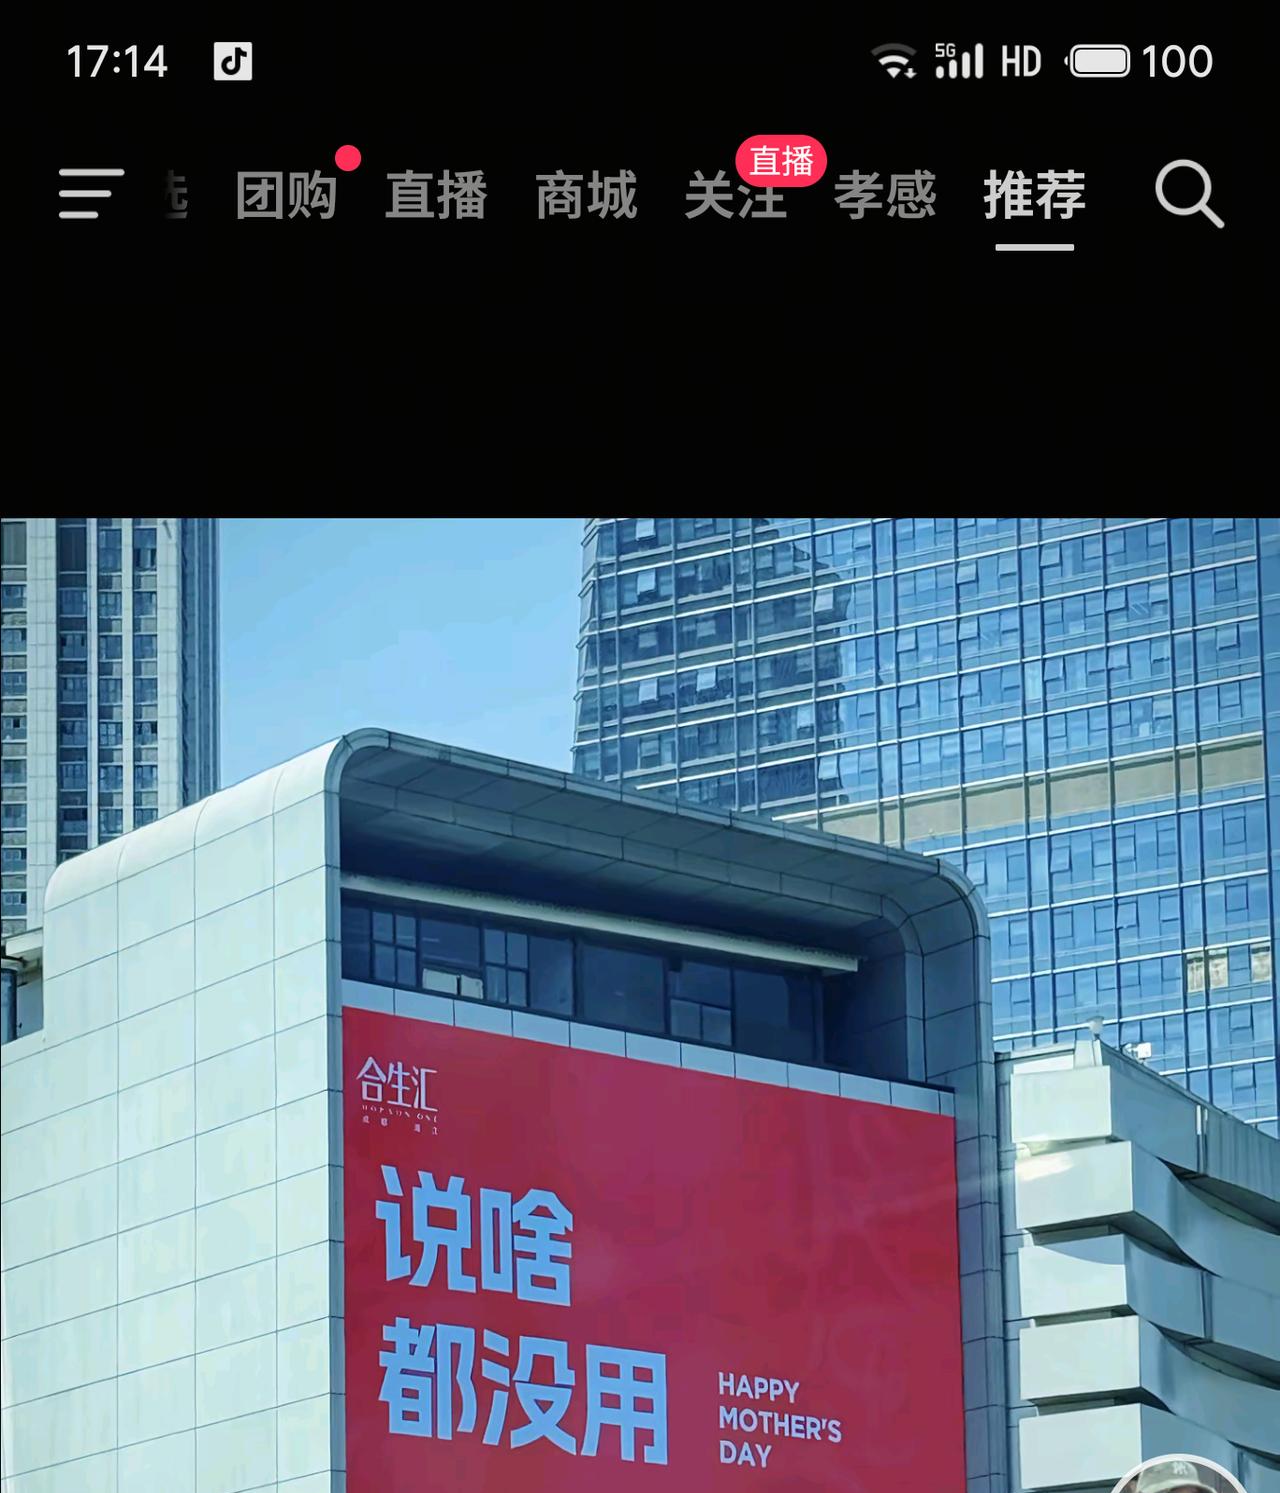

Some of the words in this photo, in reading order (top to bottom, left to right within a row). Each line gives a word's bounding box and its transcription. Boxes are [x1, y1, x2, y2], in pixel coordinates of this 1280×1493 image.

[355, 1056, 439, 1113] 合生汇
[375, 1164, 574, 1307] 说啥
[378, 1316, 669, 1466] 都没用
[718, 1371, 800, 1404] HAPPY
[719, 1405, 842, 1444] MOTHER'S
[719, 1439, 773, 1468] DAY
